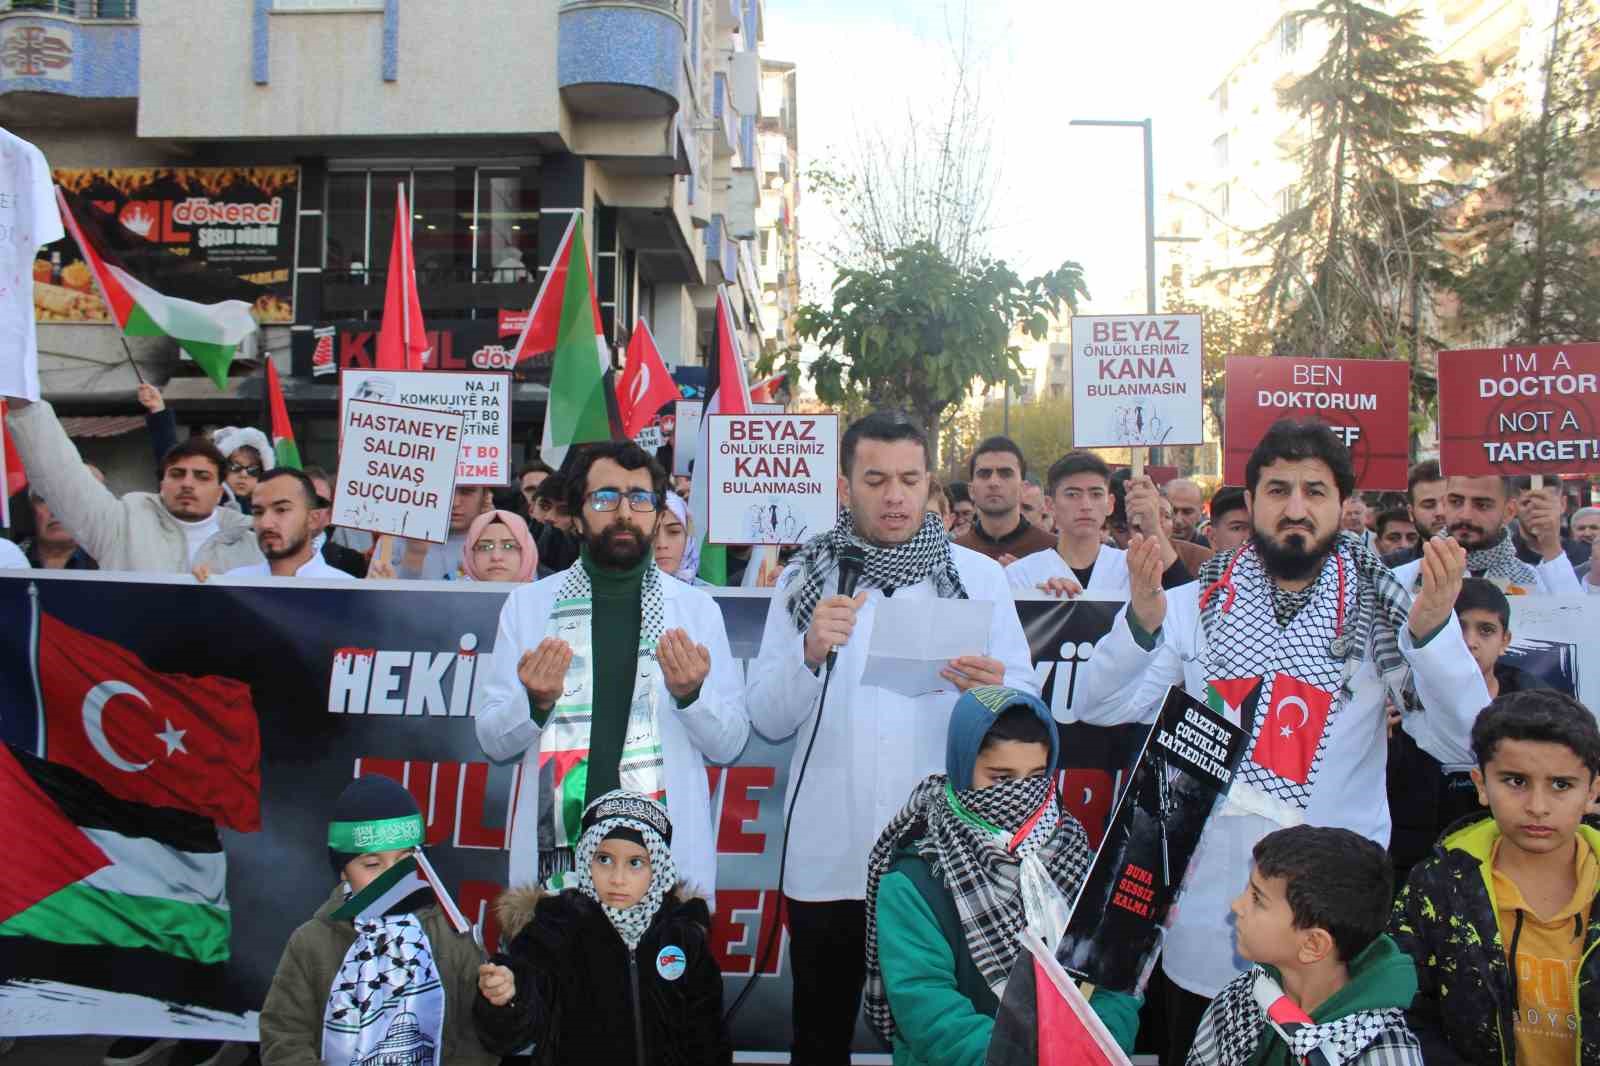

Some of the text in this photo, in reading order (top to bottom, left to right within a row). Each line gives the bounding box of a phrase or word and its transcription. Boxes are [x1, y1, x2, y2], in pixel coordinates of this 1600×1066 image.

[1092, 320, 1180, 342] BEYAZ
[1083, 343, 1189, 357] ÖNLÜKLERİMİZ
[1099, 358, 1176, 380] KANA
[1503, 351, 1571, 373] I'M A
[1293, 364, 1342, 386] BEN
[1479, 374, 1598, 398] DOCTOR
[465, 381, 500, 392] NA JI
[1087, 382, 1187, 397] BULANMASIN
[481, 396, 499, 406] RA
[1258, 390, 1377, 411] DOKTORUM
[482, 410, 500, 421] BO
[1500, 410, 1579, 433] NOT A
[350, 412, 458, 442] HASTANEYE
[729, 420, 816, 441] BEYAZ
[363, 437, 436, 462] SALDIRI
[477, 446, 499, 458] BO
[1483, 439, 1599, 462] TARGET!
[367, 460, 425, 487] SAVAŞ
[735, 457, 811, 478] KANA
[347, 480, 438, 509] SUÇUDUR
[722, 481, 822, 494] BULANMASIN
[1184, 707, 1232, 746] GAZZE'DE
[1175, 721, 1228, 763] ÇOCUKLAR
[1156, 729, 1231, 783] KATLEDİLİYOR
